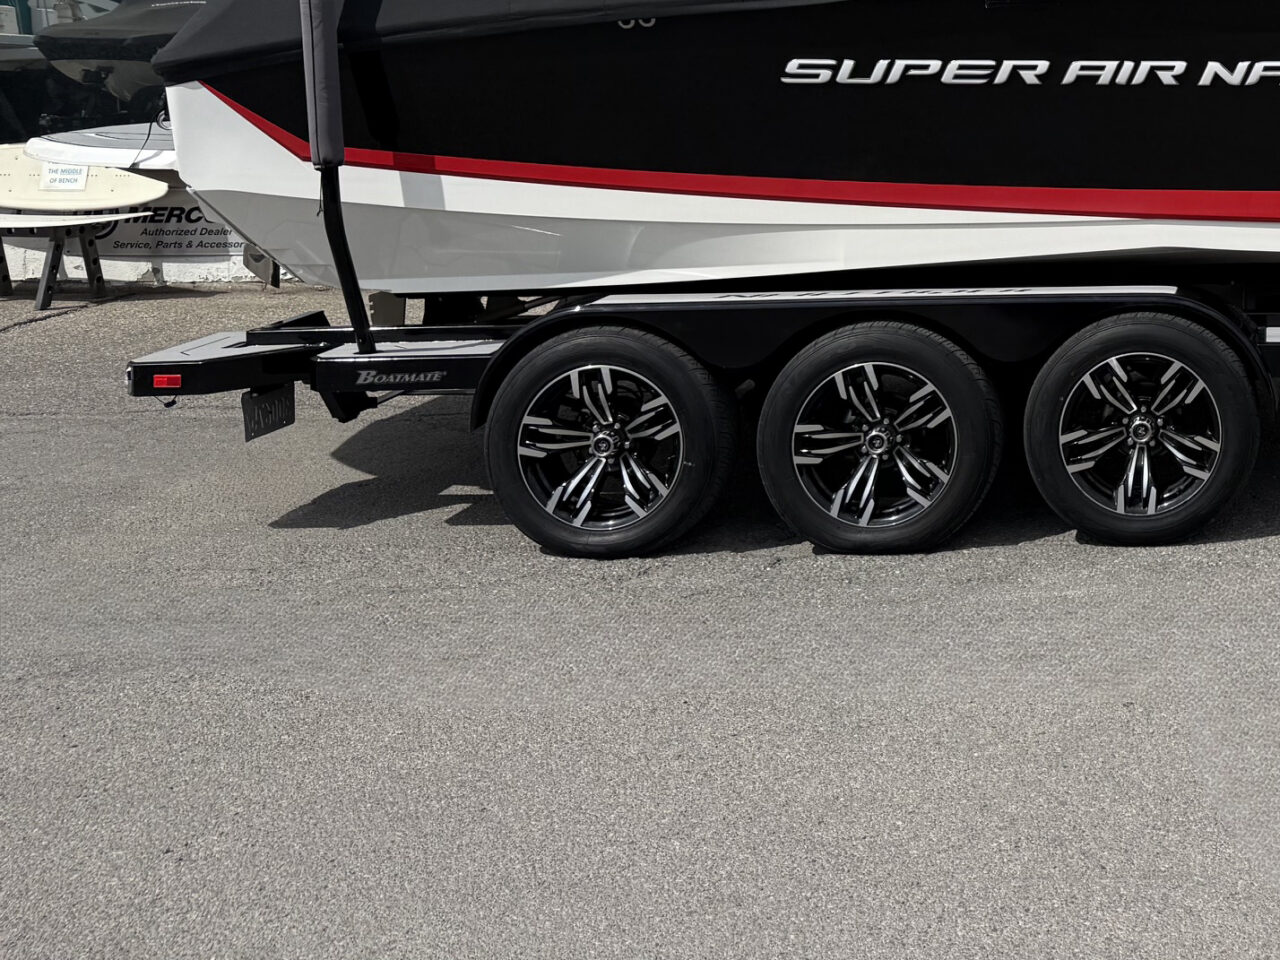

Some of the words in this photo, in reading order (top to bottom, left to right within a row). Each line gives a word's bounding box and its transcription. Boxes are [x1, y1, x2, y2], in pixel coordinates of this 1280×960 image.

[780, 58, 1051, 85] SUPER
[1061, 59, 1188, 86] AIR
[125, 206, 214, 224] MERC
[140, 227, 197, 237] Authorized
[199, 227, 233, 237] Dealer
[113, 240, 153, 250] Service,
[156, 240, 183, 249] Parts
[186, 240, 193, 249] &
